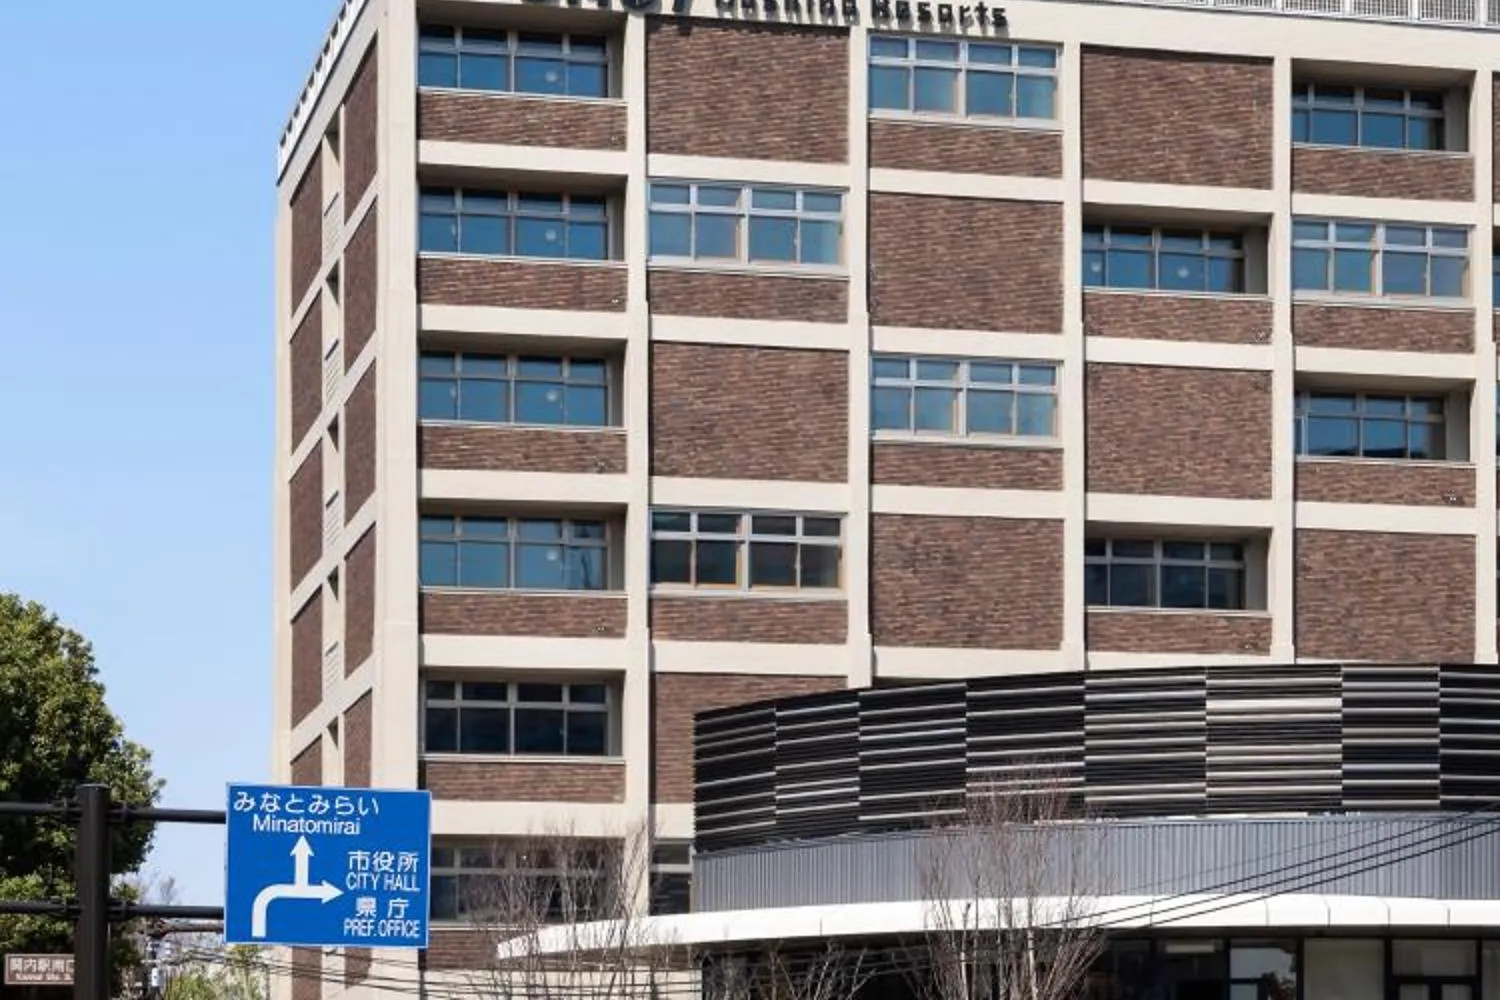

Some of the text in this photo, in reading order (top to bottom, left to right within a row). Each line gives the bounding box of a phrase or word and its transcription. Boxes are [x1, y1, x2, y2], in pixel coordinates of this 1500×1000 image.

[233, 791, 379, 816] みなとみらい
[252, 813, 361, 835] Minatomirai
[347, 850, 419, 873] 市役所
[345, 871, 421, 892] CITY HALL
[355, 896, 409, 919] 県庁
